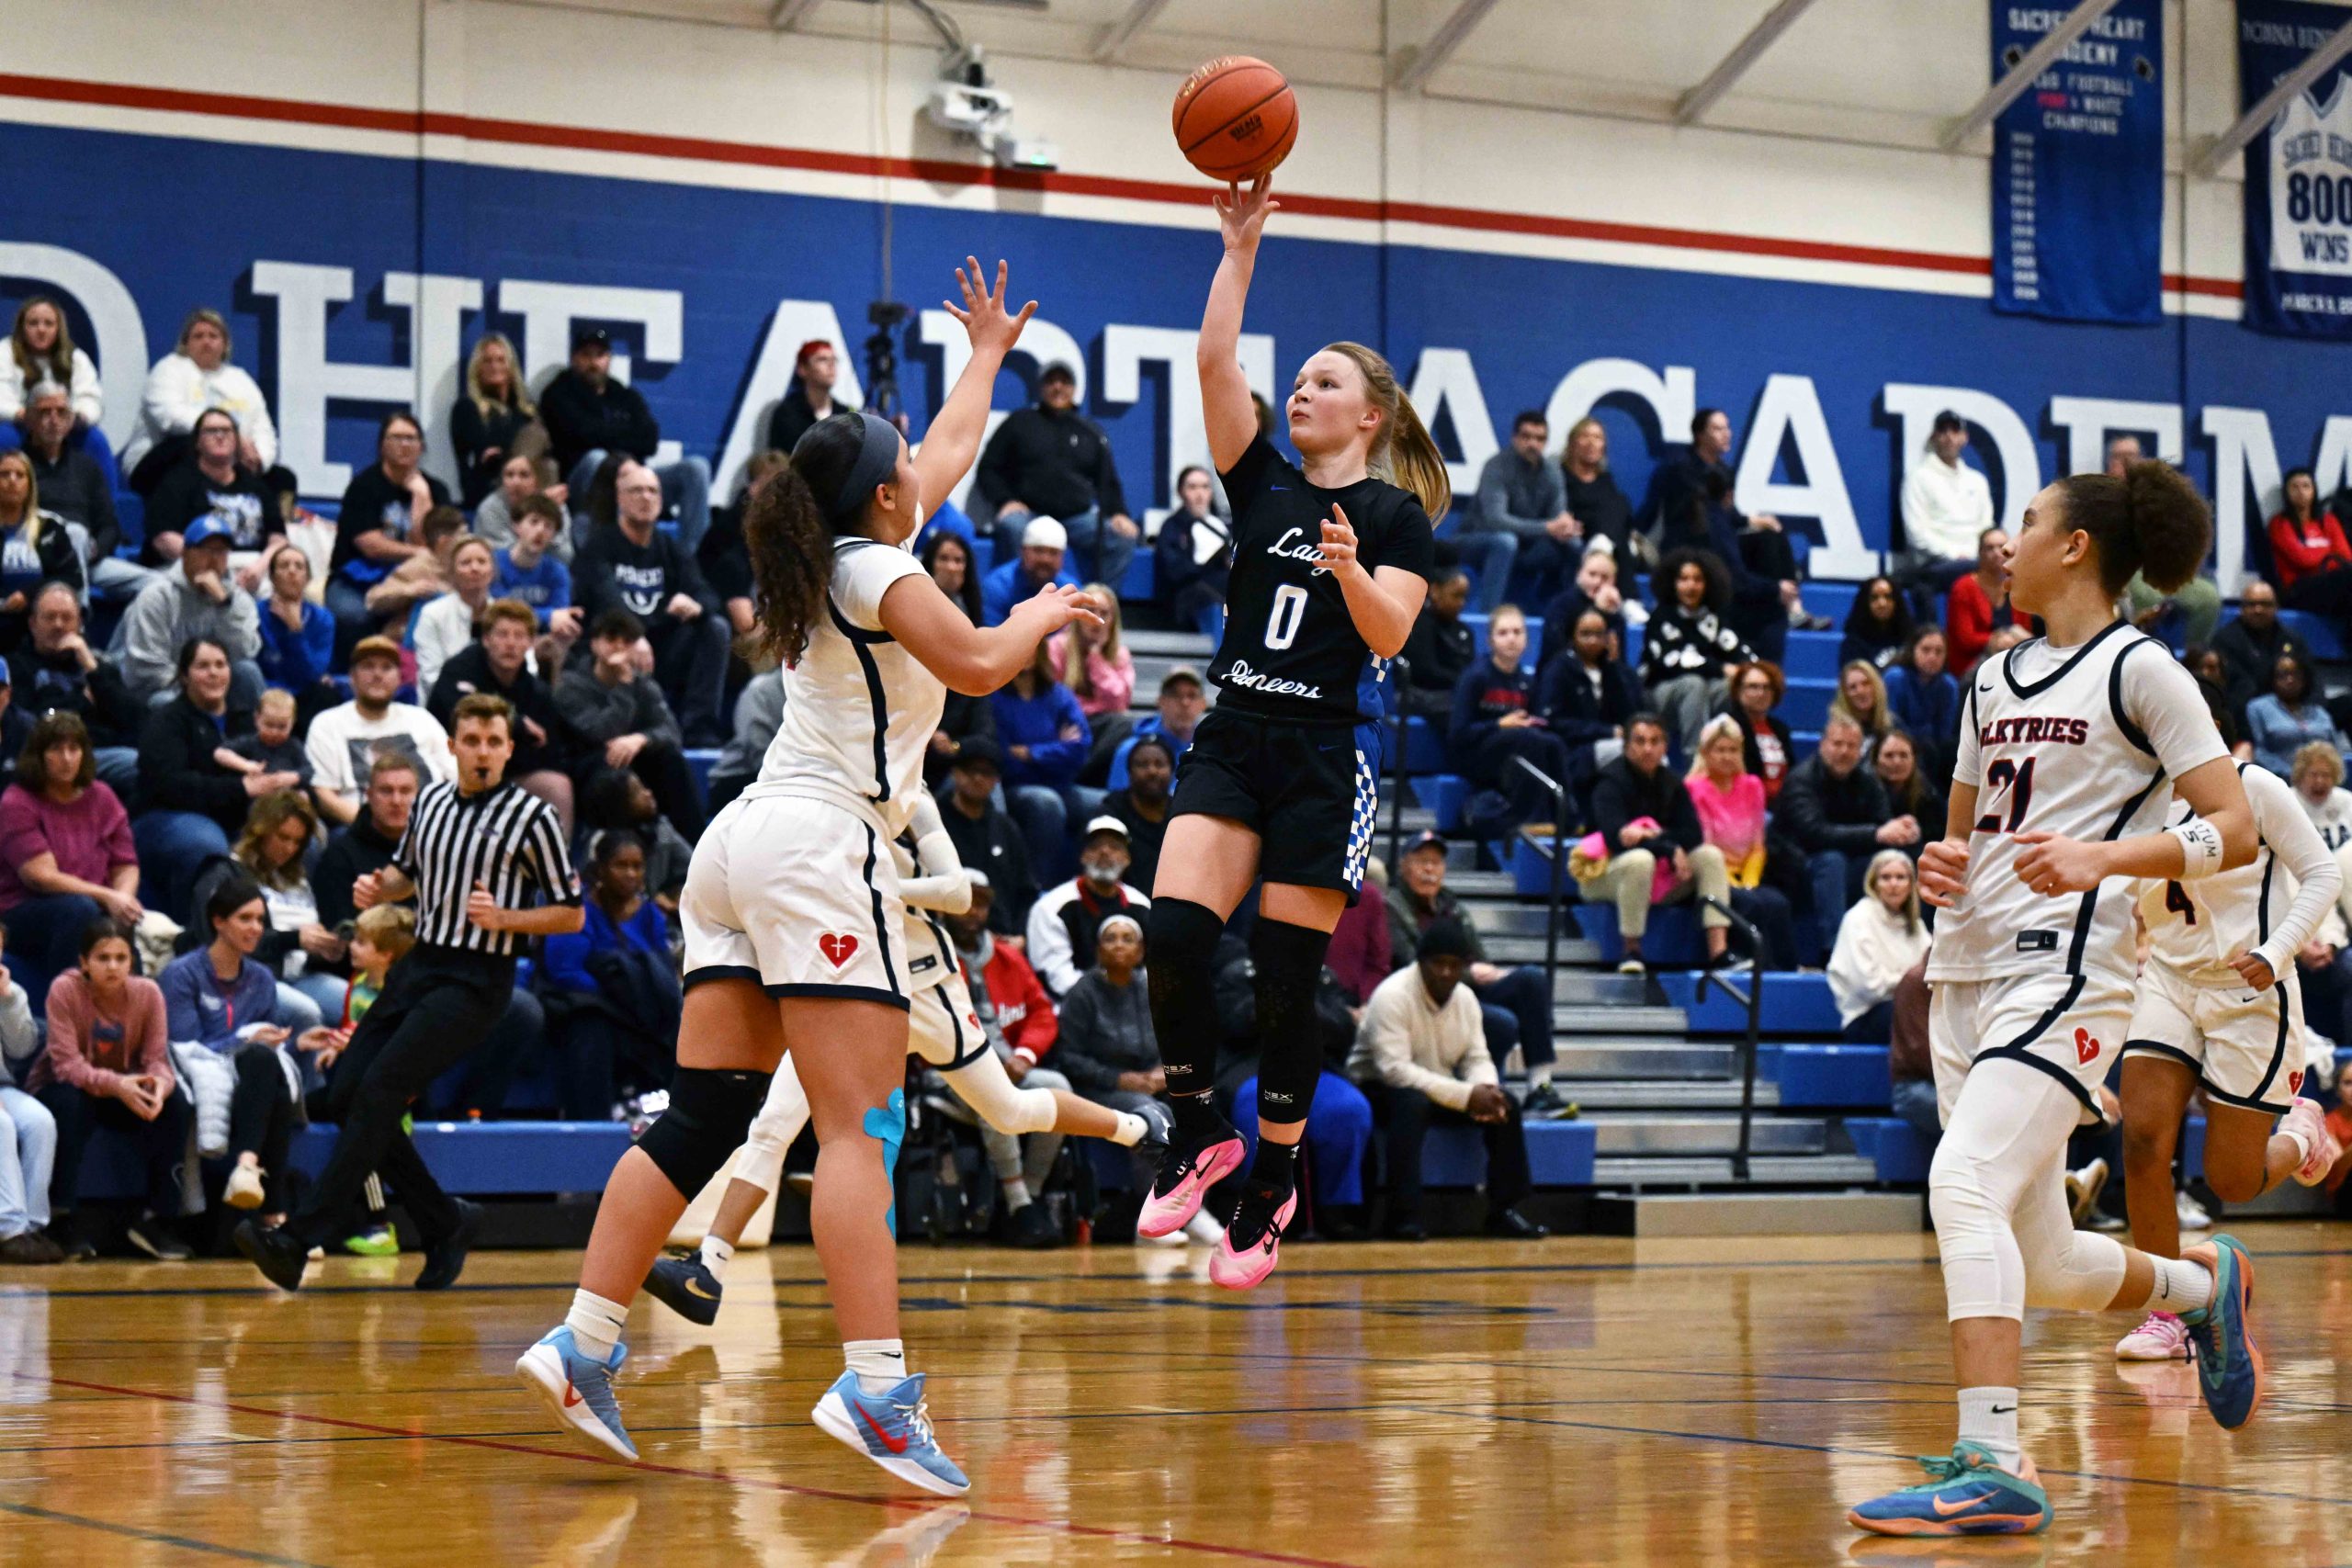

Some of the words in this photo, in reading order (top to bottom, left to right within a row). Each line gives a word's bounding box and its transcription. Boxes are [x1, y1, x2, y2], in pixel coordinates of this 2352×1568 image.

[2007, 8, 2067, 33] SACR
[2289, 172, 2352, 226] 800
[1264, 584, 1308, 650] 0
[1982, 716, 2089, 748] LKYRIES
[1975, 756, 2037, 834] 21
[2165, 879, 2197, 926] 4
